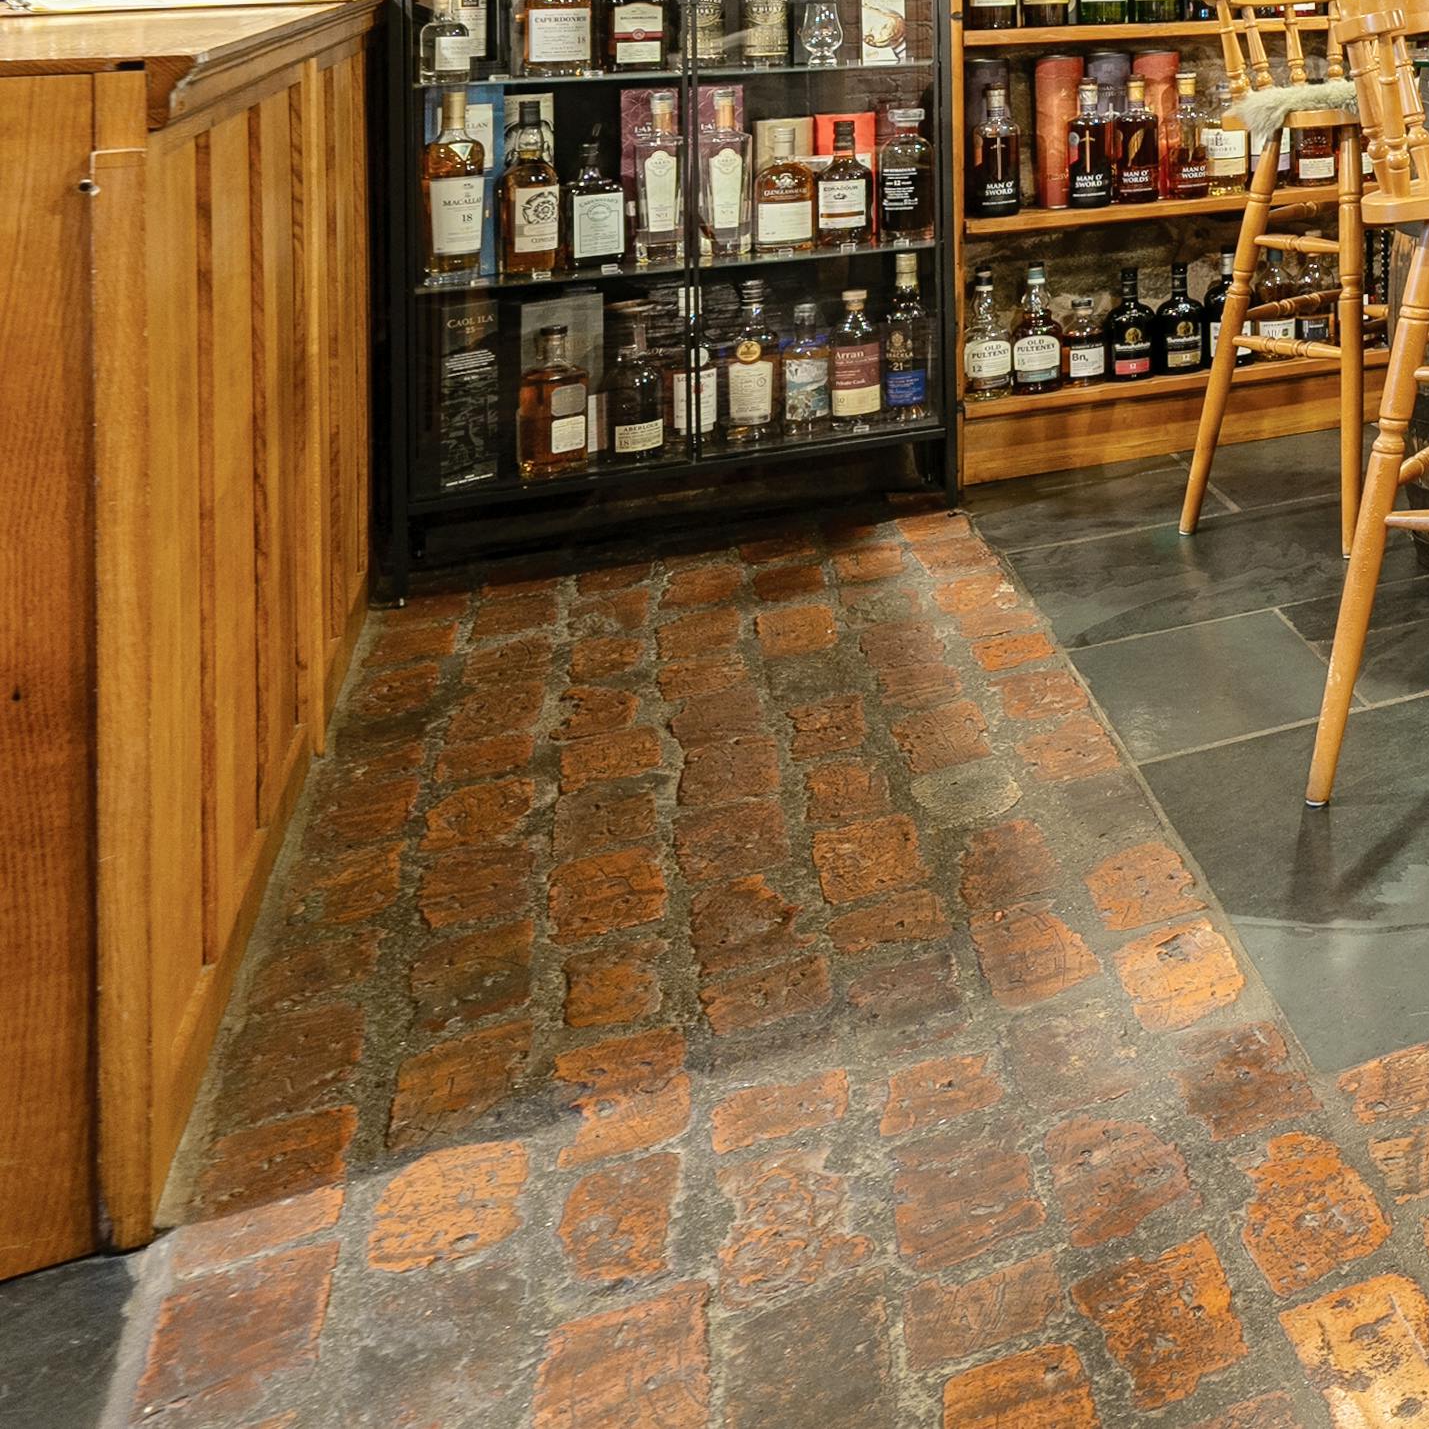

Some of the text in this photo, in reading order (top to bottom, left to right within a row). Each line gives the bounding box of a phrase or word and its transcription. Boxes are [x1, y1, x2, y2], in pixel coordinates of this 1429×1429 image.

[986, 182, 1005, 190] MAN
[1075, 180, 1103, 188] SWORD
[985, 188, 1013, 196] SWORD
[462, 213, 473, 222] 18
[446, 314, 494, 328] CAOL ILA
[984, 344, 1001, 352] OLD
[1017, 343, 1056, 353] PULTENEY
[835, 349, 864, 360] Arran
[892, 362, 904, 371] 21
